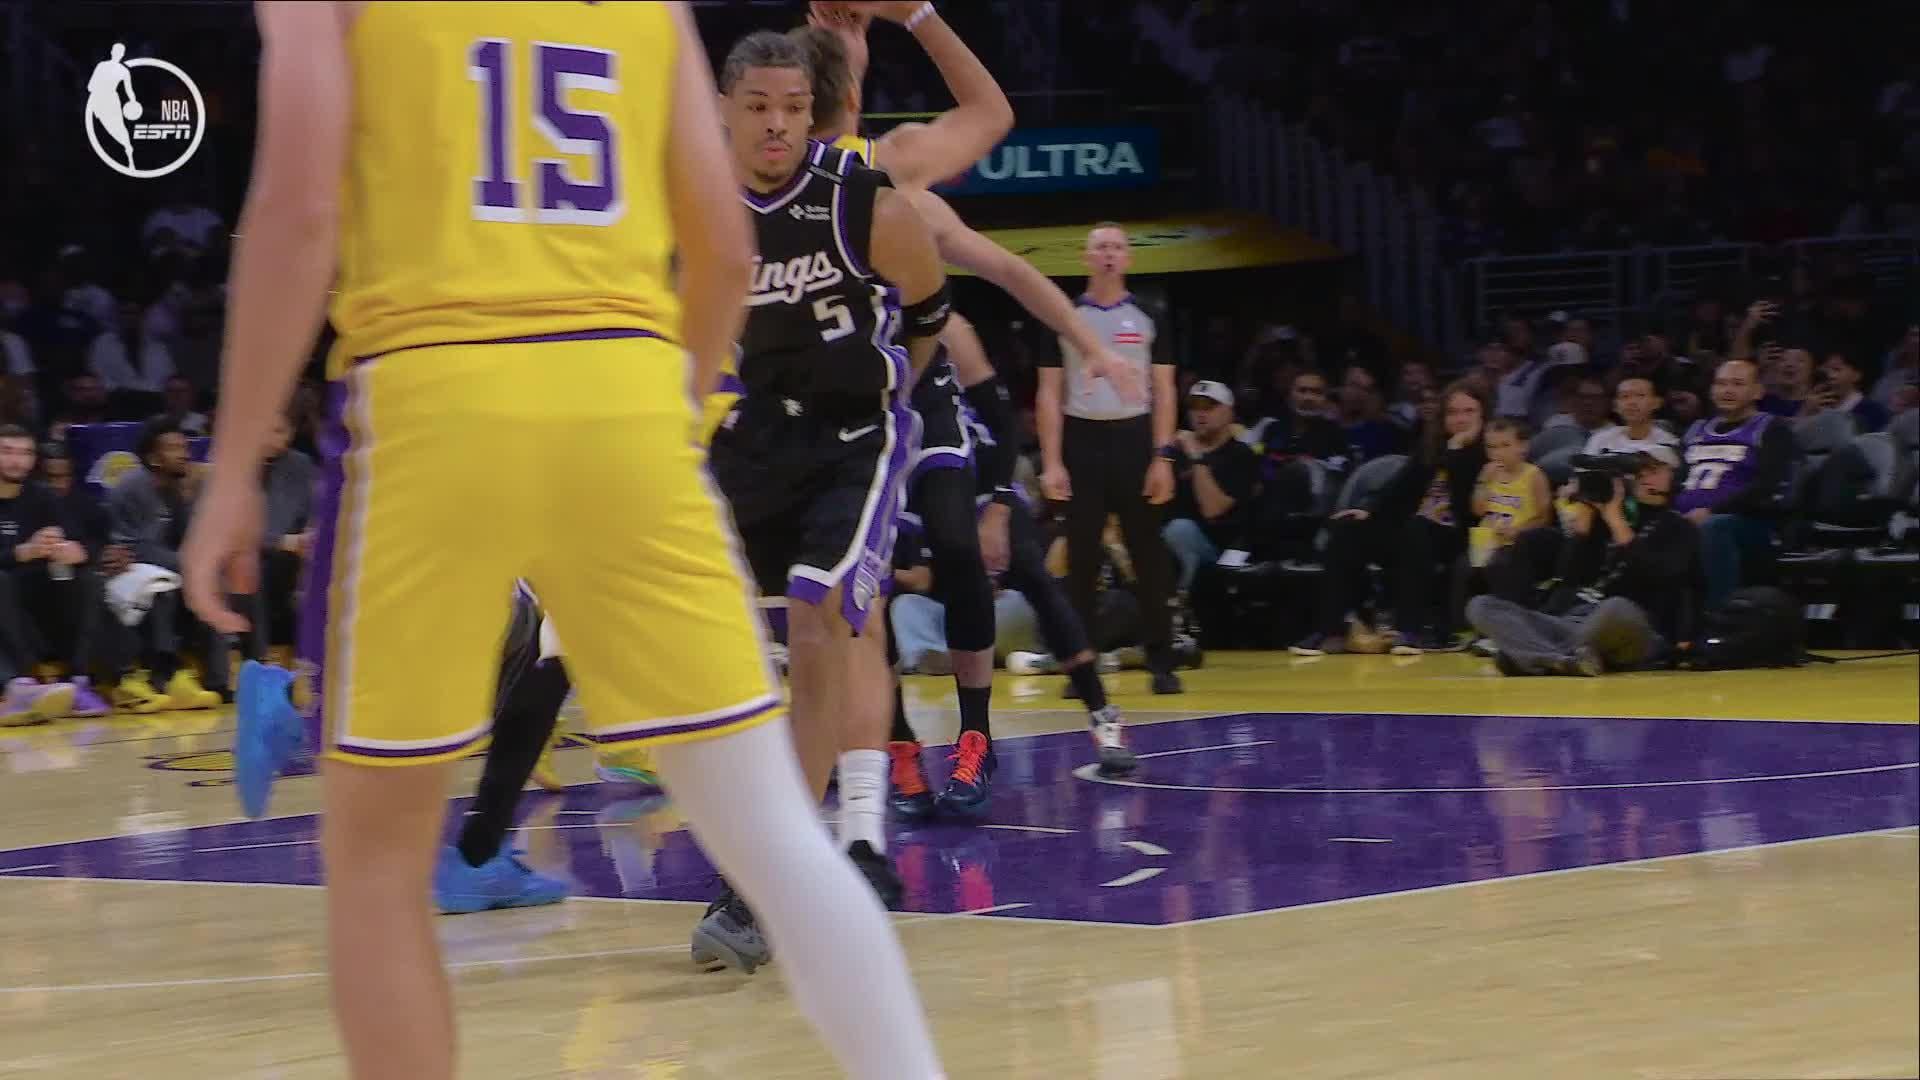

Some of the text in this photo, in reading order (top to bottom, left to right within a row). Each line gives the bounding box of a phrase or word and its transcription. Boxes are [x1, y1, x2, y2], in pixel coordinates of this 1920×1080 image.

[466, 37, 629, 226] 15
[977, 141, 1145, 180] ULTRA
[745, 250, 843, 306] ings
[812, 294, 856, 341] 5
